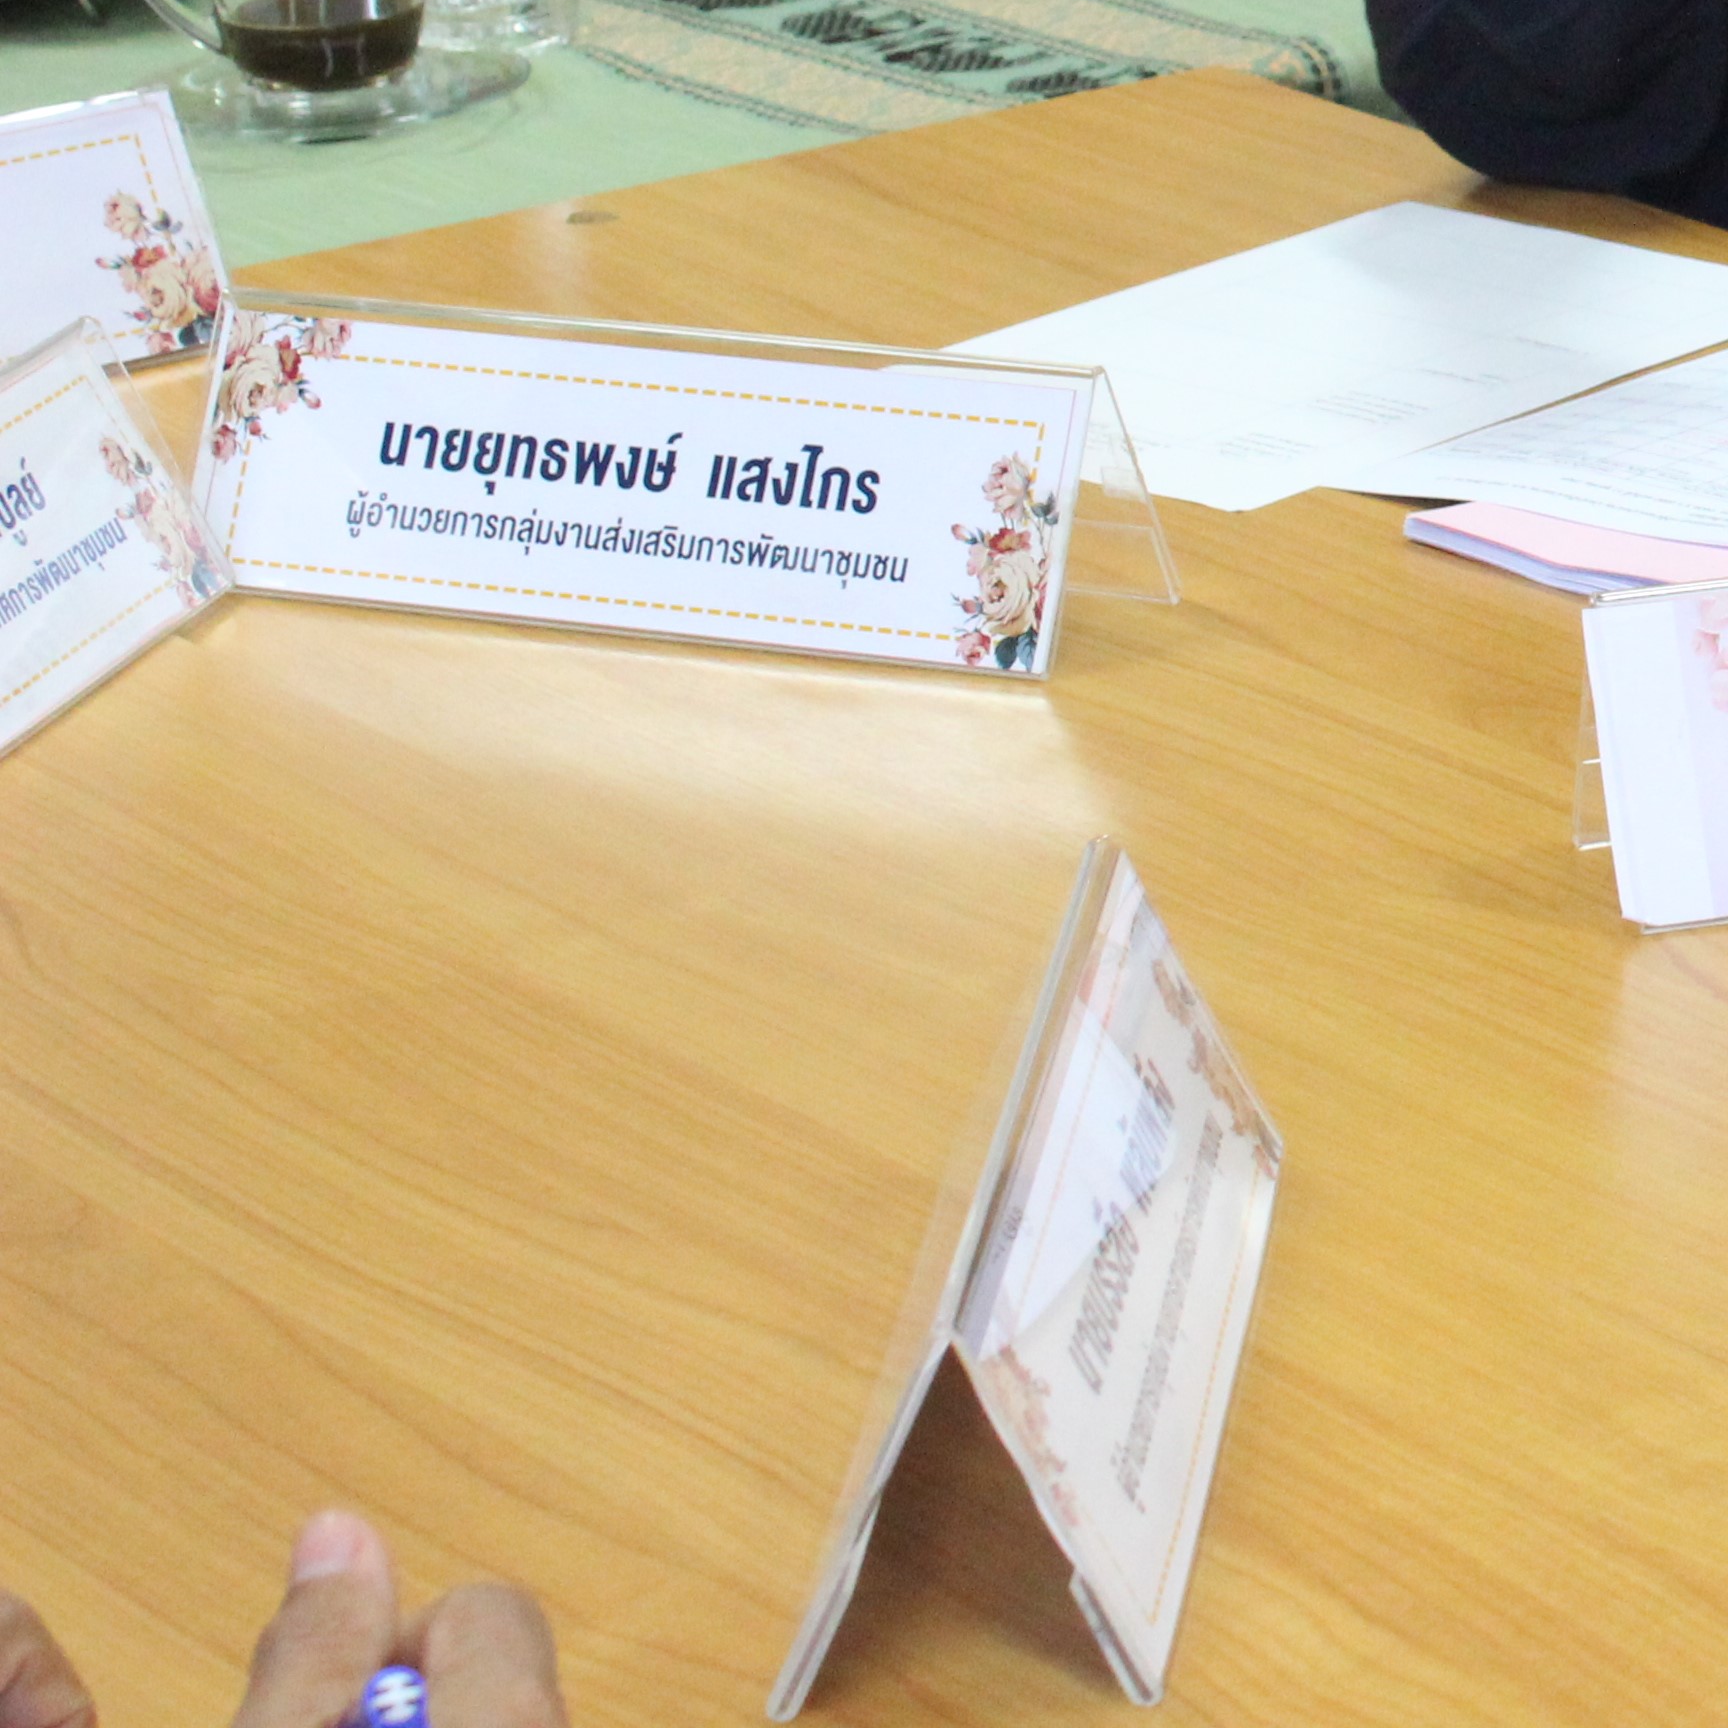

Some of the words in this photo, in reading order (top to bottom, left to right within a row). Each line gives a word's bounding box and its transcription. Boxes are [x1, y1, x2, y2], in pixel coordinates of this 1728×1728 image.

[379, 421, 683, 495] นายยุทธพงษ์
[706, 443, 881, 515] แสงไกร
[346, 489, 909, 590] ผู้อำนวยการกลุ่มงานส่งเสริมการพัฒนาชุมชน
